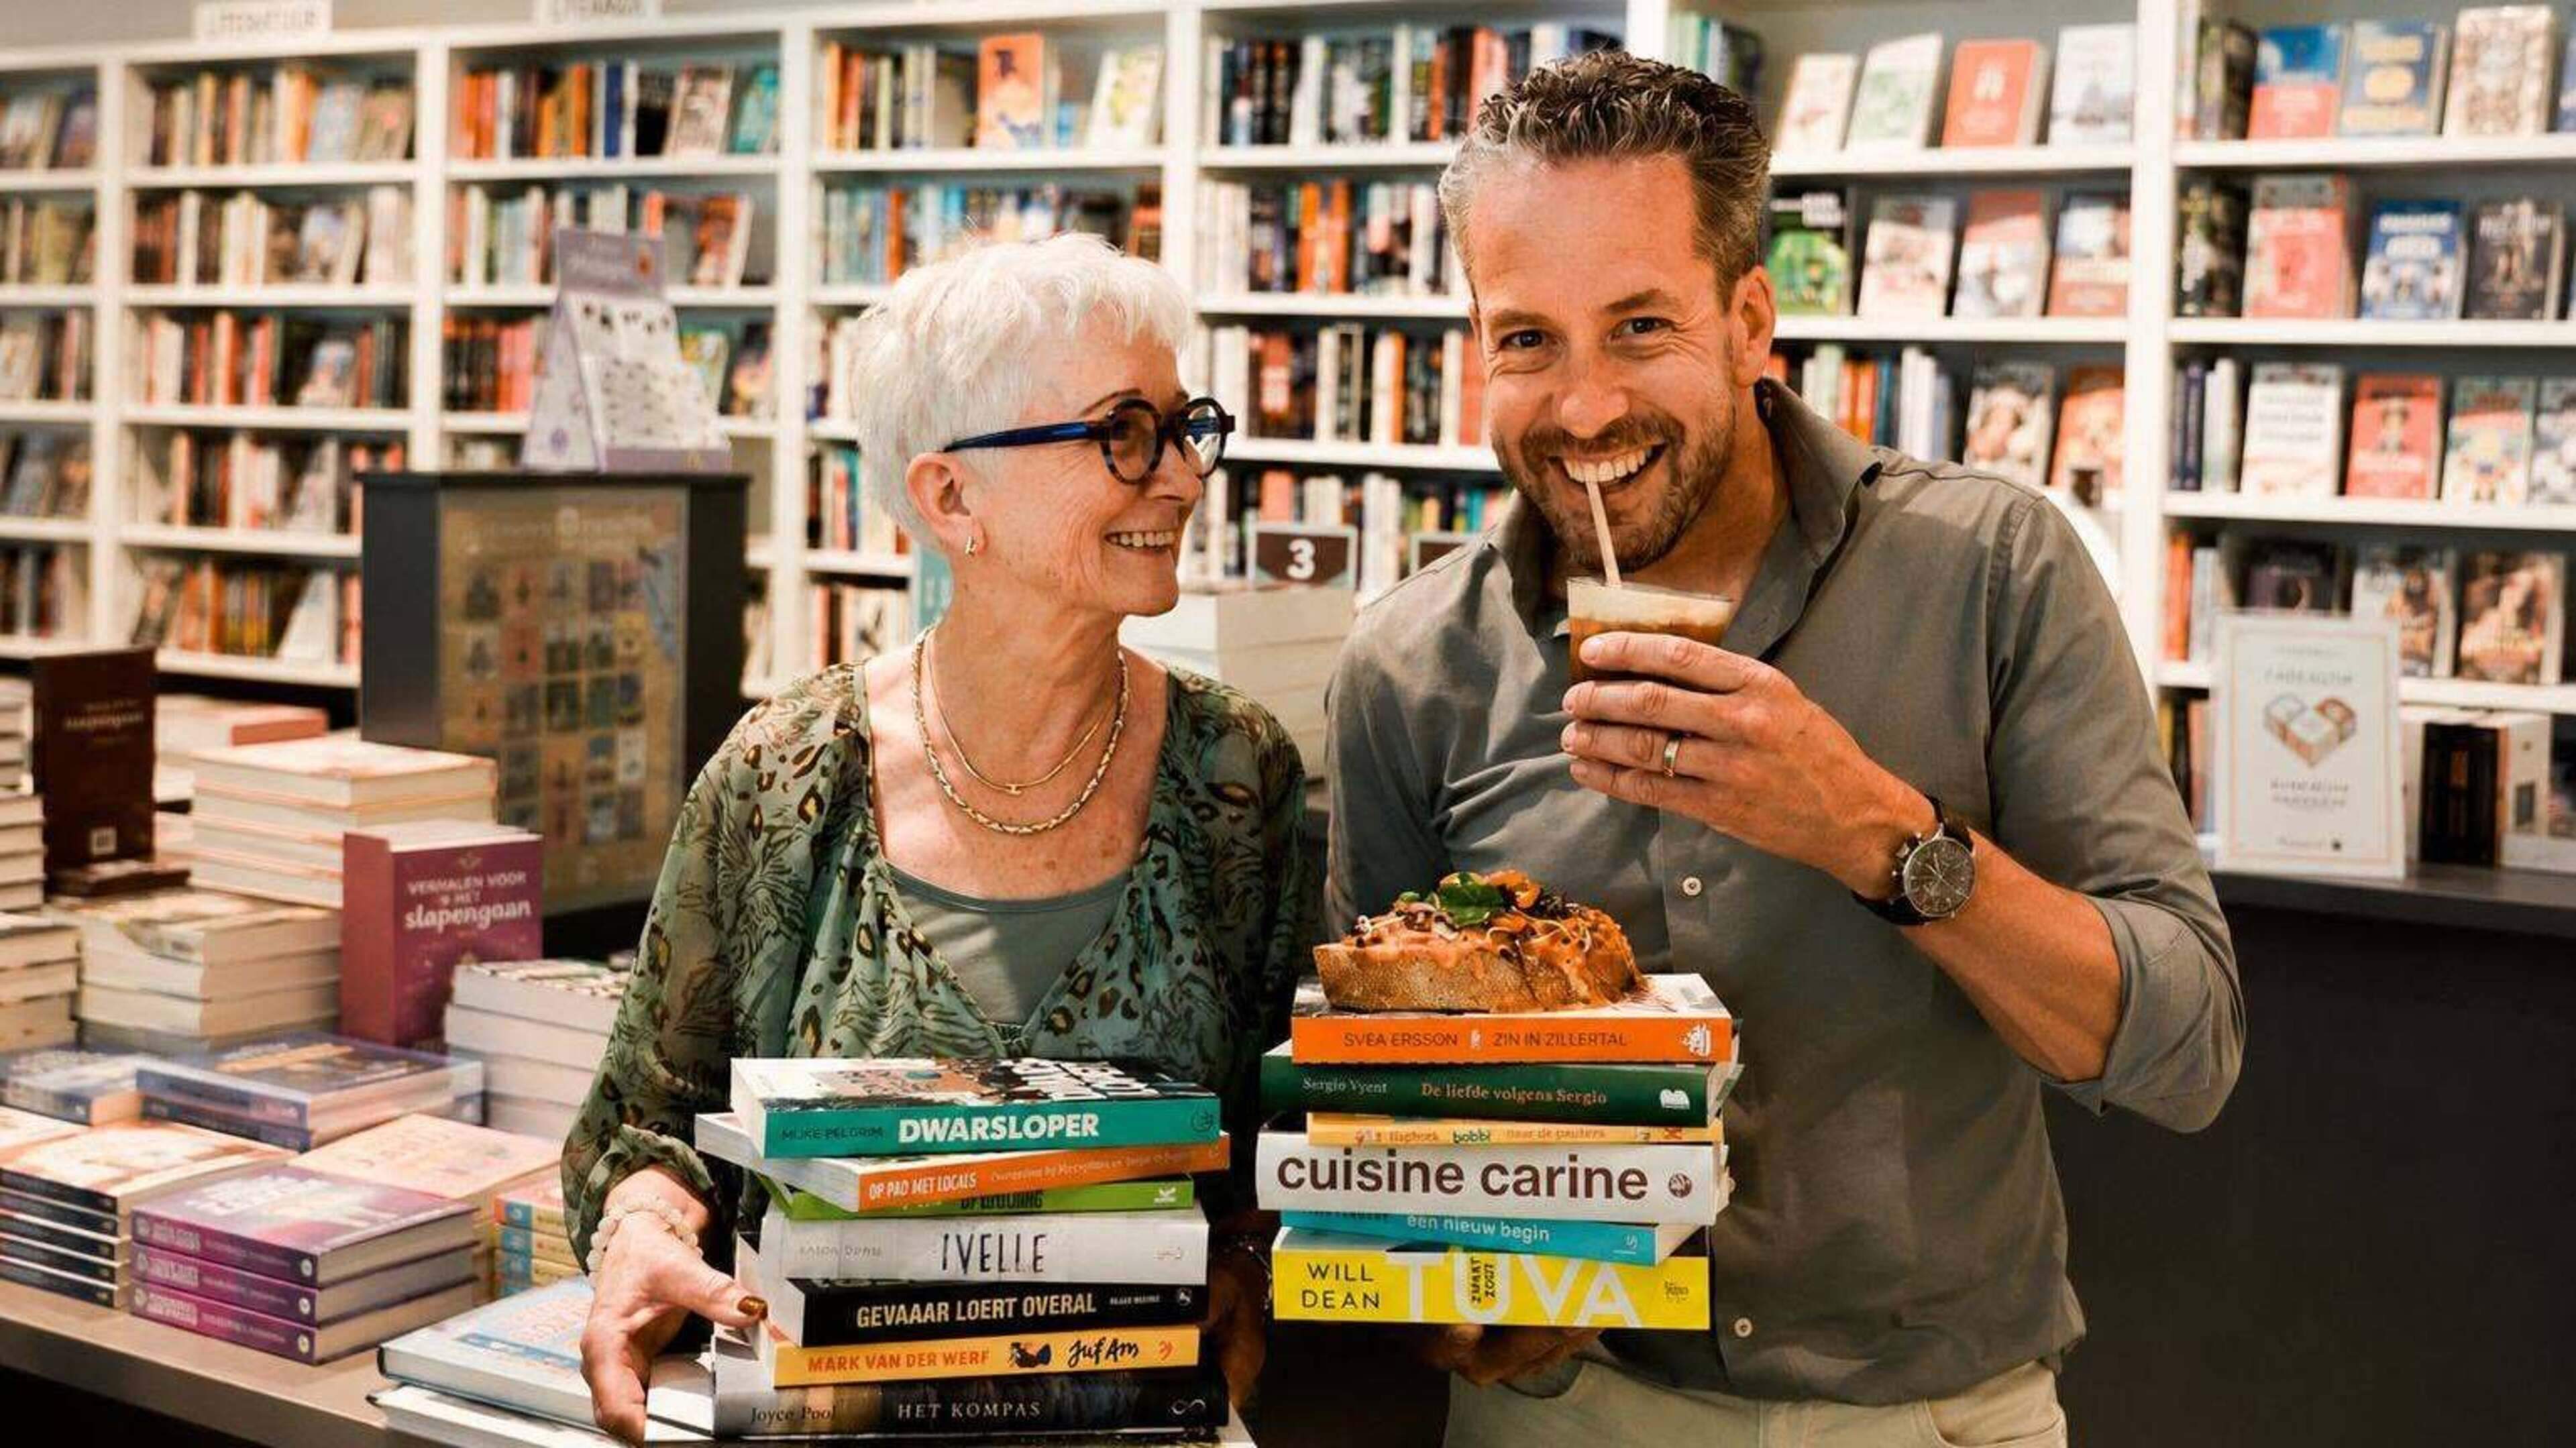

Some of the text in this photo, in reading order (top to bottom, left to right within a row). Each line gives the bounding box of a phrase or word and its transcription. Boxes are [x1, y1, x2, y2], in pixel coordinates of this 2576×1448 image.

[1286, 539, 1316, 579] 3
[407, 872, 527, 895] VERHALEN VOOR
[455, 891, 481, 904] HET
[1344, 1032, 1458, 1048] SVEA ERSSON
[1493, 1032, 1628, 1047] ZIN IN ZILLERTAL
[1301, 1076, 1346, 1094] Sergio
[1421, 1082, 1607, 1105] De liefde volgens Sergio
[898, 1113, 1099, 1143] DWARSLOPER
[1277, 1148, 1648, 1201] cuisine carine
[869, 1182, 884, 1201] OP
[887, 1179, 908, 1198] PAD
[911, 1177, 936, 1194] MET
[937, 1172, 977, 1192] LOCALS
[1407, 1211, 1438, 1230] een
[1444, 1219, 1496, 1236] nieuw
[1501, 1221, 1550, 1243] begin
[942, 1233, 1046, 1274] IVELLE
[1307, 1262, 1375, 1282] WILL
[1302, 1289, 1380, 1310] DEAN
[1386, 1249, 1644, 1328] TUVA
[856, 1301, 950, 1328] GEVAAAR
[956, 1298, 1018, 1321] LOERT
[1022, 1293, 1097, 1317] OVERAL
[807, 1349, 990, 1373] MARK VAN DER WERF
[750, 1404, 837, 1427] Joyce Pool
[898, 1400, 1042, 1419] HET KOMPAS
